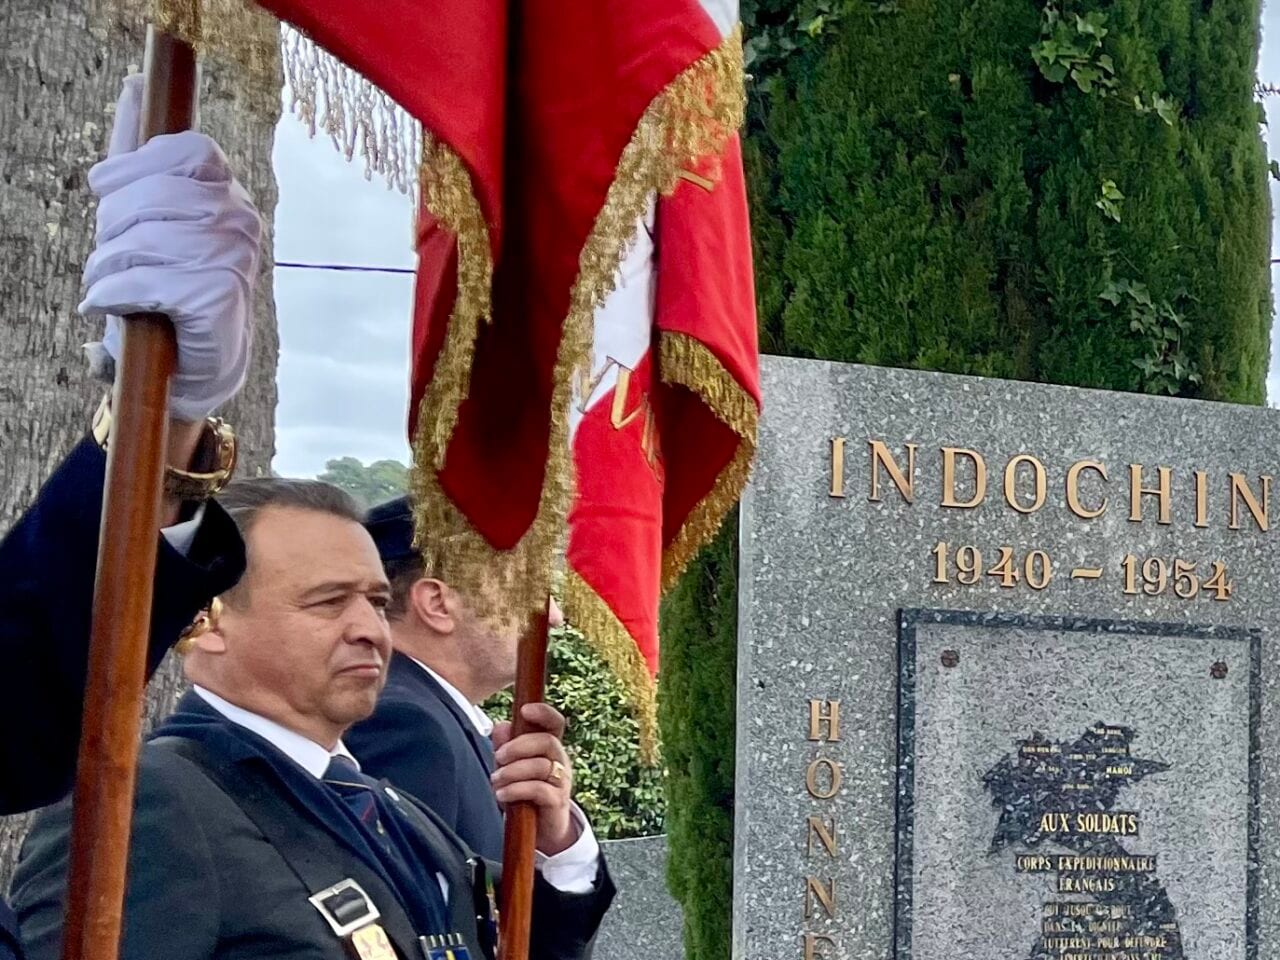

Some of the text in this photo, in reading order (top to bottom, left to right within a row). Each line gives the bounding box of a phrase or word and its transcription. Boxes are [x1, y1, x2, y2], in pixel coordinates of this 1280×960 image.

[932, 541, 1053, 590] 1940
[1122, 553, 1233, 601] 1954
[1040, 813, 1137, 834] AUX SOLDATS
[1017, 856, 1154, 872] CORPS EXPEDITIONNAIRE
